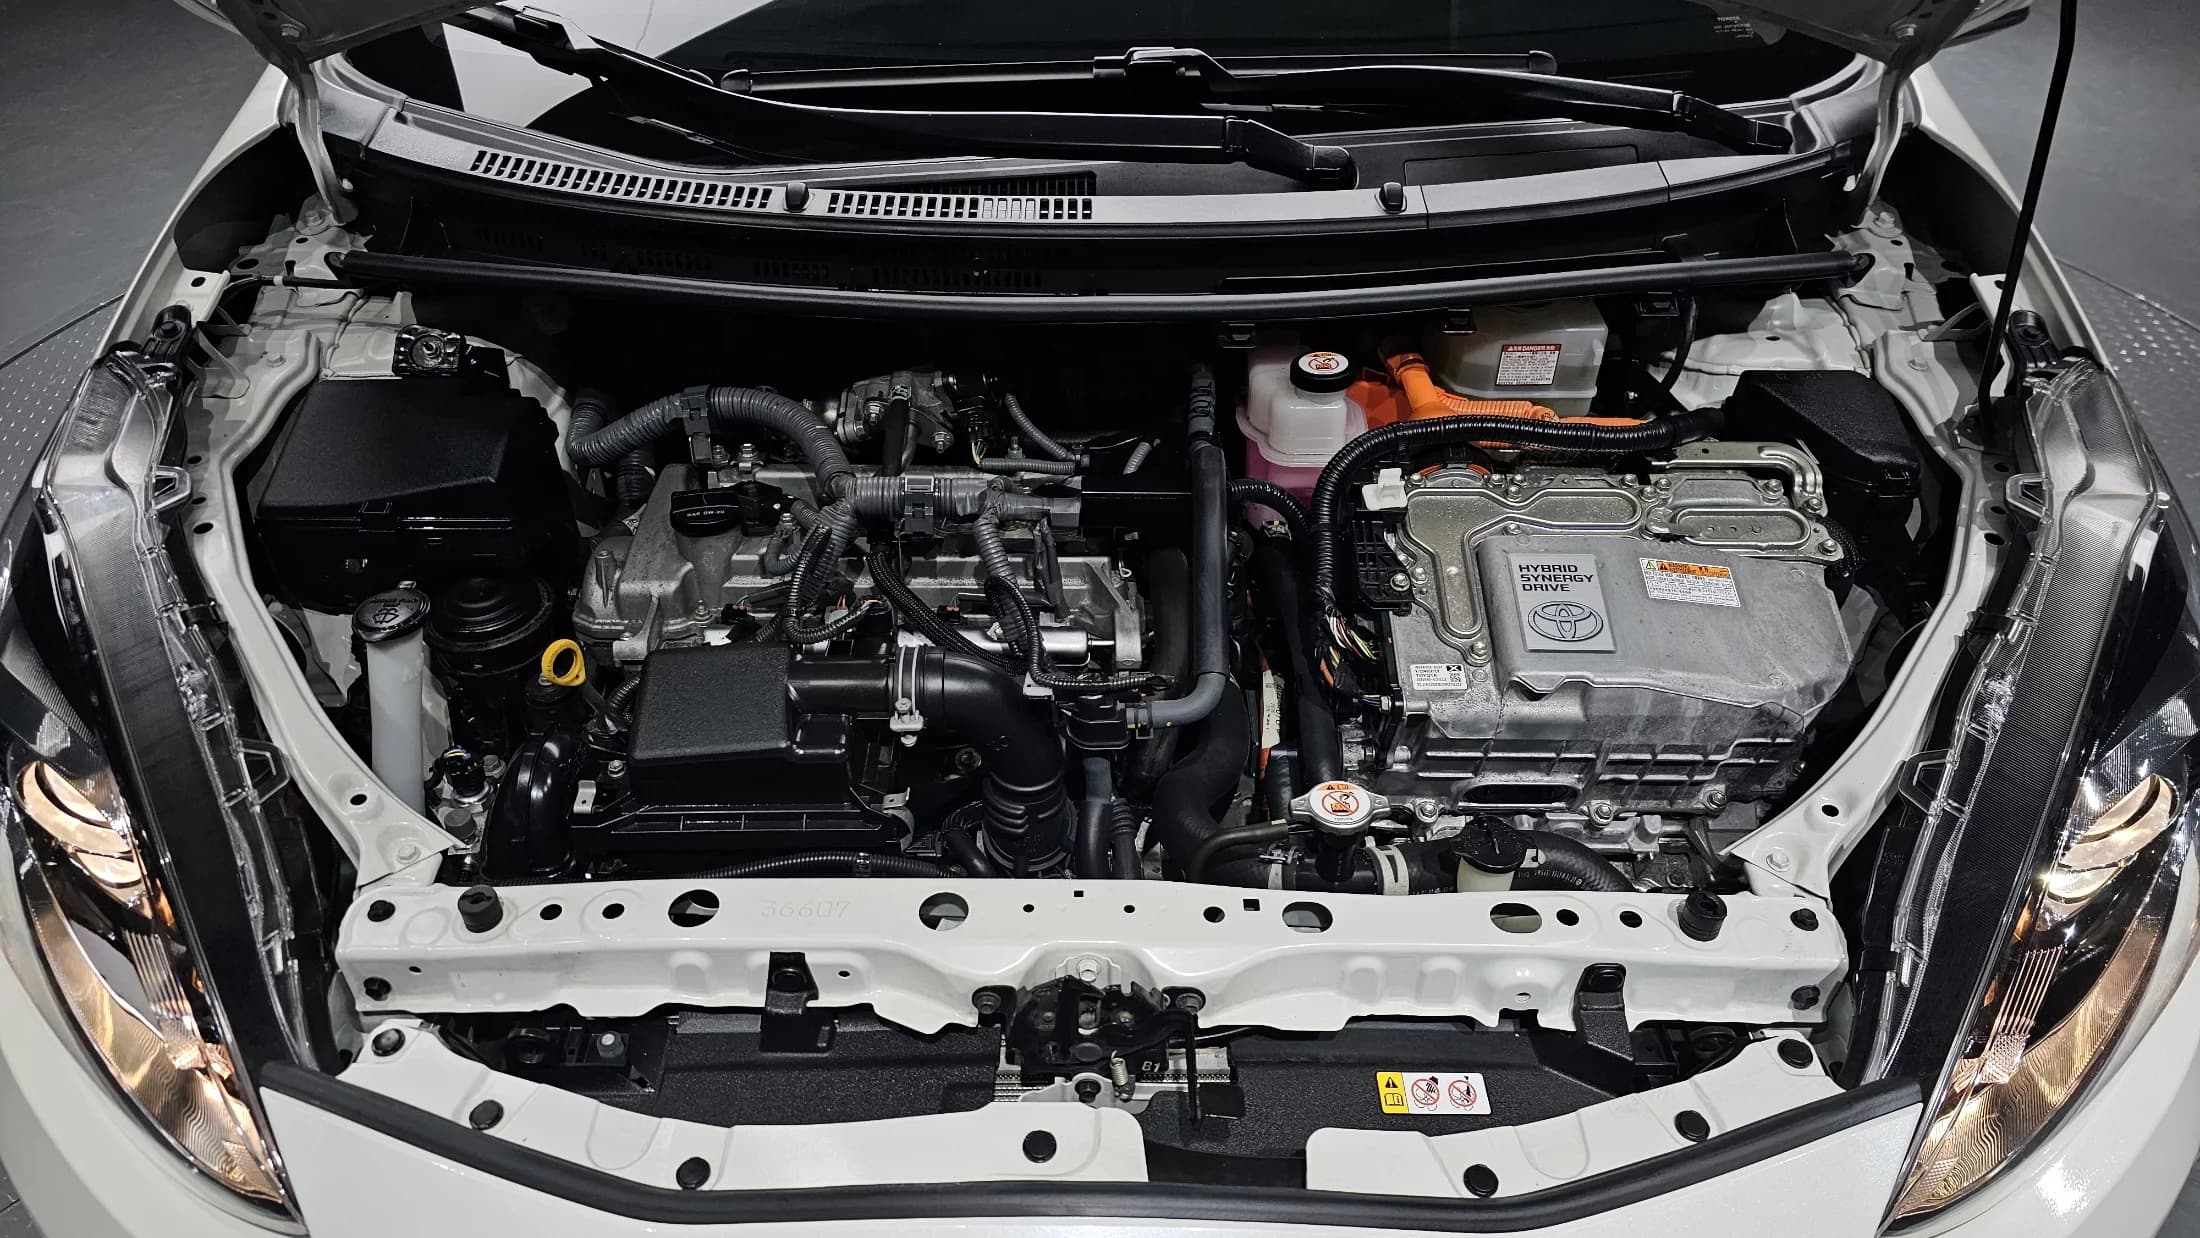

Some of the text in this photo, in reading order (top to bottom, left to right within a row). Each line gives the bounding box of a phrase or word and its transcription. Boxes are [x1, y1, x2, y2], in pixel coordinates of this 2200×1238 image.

[1518, 564, 1578, 573] HYBRID
[1520, 574, 1594, 583] SYNERGY
[1522, 583, 1571, 592] DRIVE
